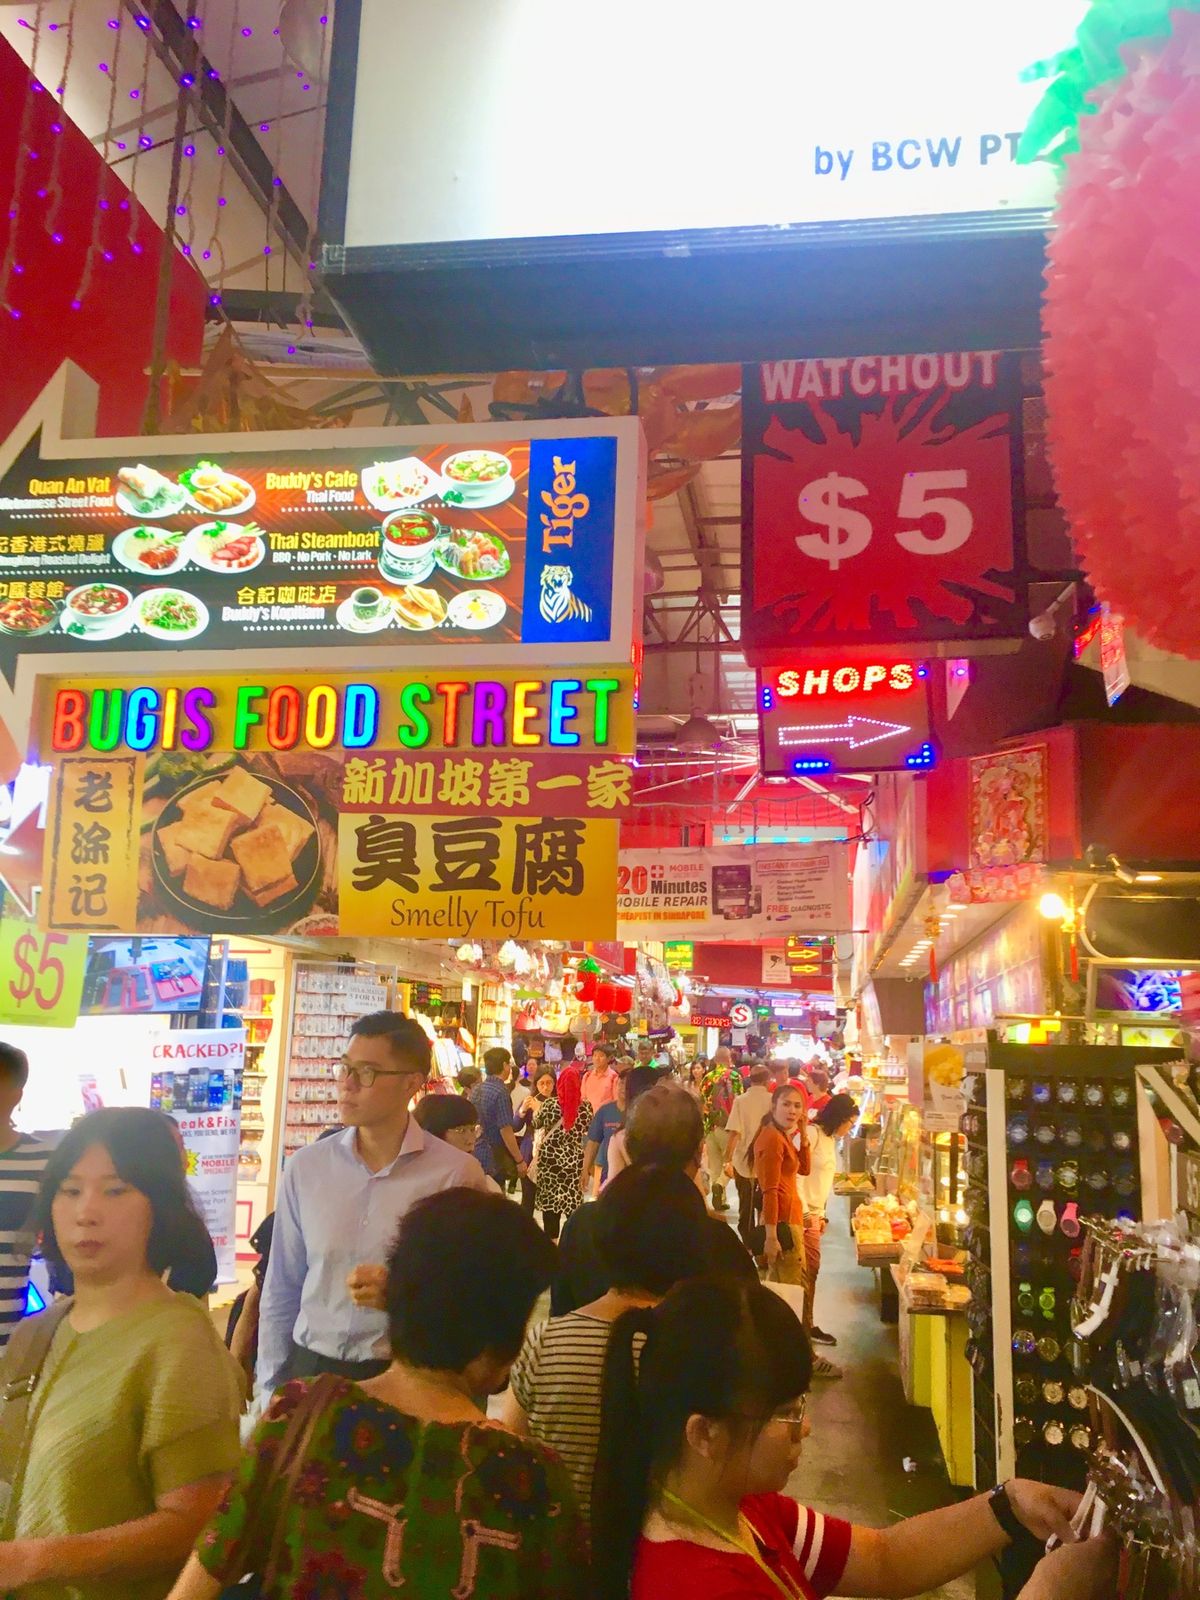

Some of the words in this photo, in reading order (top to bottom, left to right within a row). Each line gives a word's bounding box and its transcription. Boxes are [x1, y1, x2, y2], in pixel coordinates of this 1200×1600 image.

[815, 146, 854, 181] by
[872, 136, 962, 171] BCW
[980, 132, 1025, 165] PT
[762, 351, 1000, 400] WATCHOUT
[265, 471, 323, 490] Buddy's
[324, 470, 358, 488] Cafe
[89, 495, 114, 508] Food
[306, 490, 328, 503] Thai
[329, 489, 355, 502] Food
[540, 455, 590, 553] Tiger
[269, 533, 299, 550] Thai
[301, 531, 380, 549] Steamboat
[273, 552, 292, 564] BBQ
[297, 551, 310, 562] No
[311, 550, 332, 561] Pork
[338, 550, 351, 561] No
[237, 585, 336, 605] 合記咖啡店
[777, 664, 912, 697] SHOPS
[52, 686, 216, 752] BUGIS
[233, 683, 379, 751] FOOD
[397, 678, 620, 748] STREET
[342, 757, 633, 809] 新加坡第一家
[352, 814, 586, 896] 臭豆腐
[616, 866, 648, 895] 20
[651, 880, 707, 894] Minutes
[664, 896, 708, 907] REPAIR
[767, 905, 789, 913] FREE
[390, 896, 479, 937] Smelly
[485, 896, 545, 938] Tofu
[9, 928, 69, 1011] $5
[153, 1043, 243, 1058] CRACKED?!
[178, 1116, 237, 1129] eak&Fix
[201, 1159, 236, 1167] MOBILE
